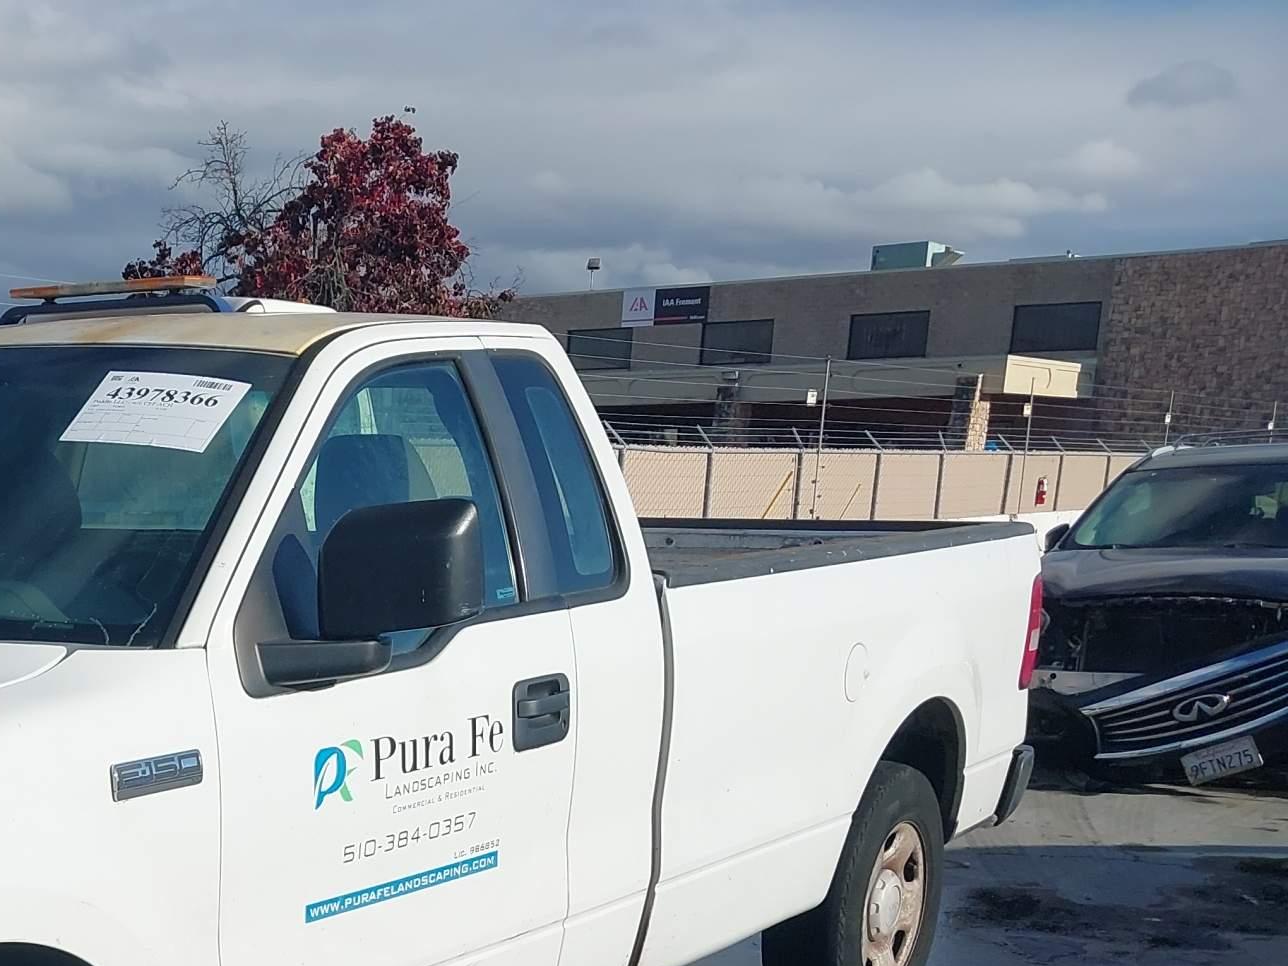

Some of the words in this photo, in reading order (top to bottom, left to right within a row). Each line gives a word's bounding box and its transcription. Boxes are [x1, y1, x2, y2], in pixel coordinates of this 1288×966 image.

[106, 386, 224, 408] 43978366
[370, 731, 456, 781] Pura
[467, 714, 504, 758] Fe
[1190, 749, 1254, 779] 9FTN275
[384, 767, 471, 799] LANDSCAPING
[437, 794, 443, 802] &
[342, 811, 478, 864] 510-384-0357
[309, 855, 495, 919] WWW.PURAFELANDSCAPING.COM
